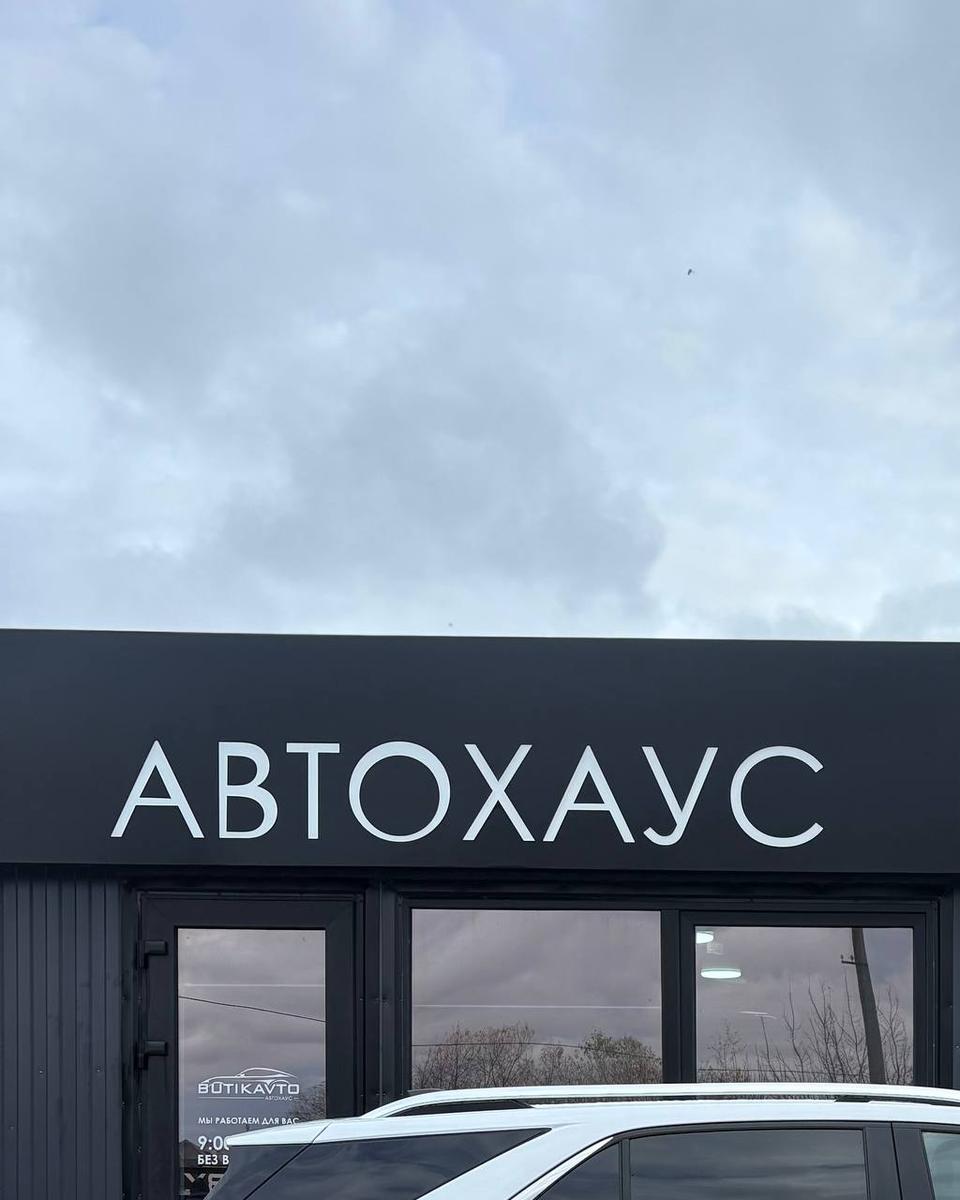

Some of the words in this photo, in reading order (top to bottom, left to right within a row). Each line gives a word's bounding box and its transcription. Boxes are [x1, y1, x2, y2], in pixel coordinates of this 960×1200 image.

[110, 740, 825, 848] АВТОХАУС
[198, 1083, 300, 1095] BUTIKAVTO
[198, 1117, 213, 1125] МЫ
[215, 1117, 260, 1125] РАБОТАЕМ
[262, 1117, 280, 1126] ДЛЯ
[281, 1117, 300, 1125] ВАС
[198, 1154, 218, 1165] БЕЗ
